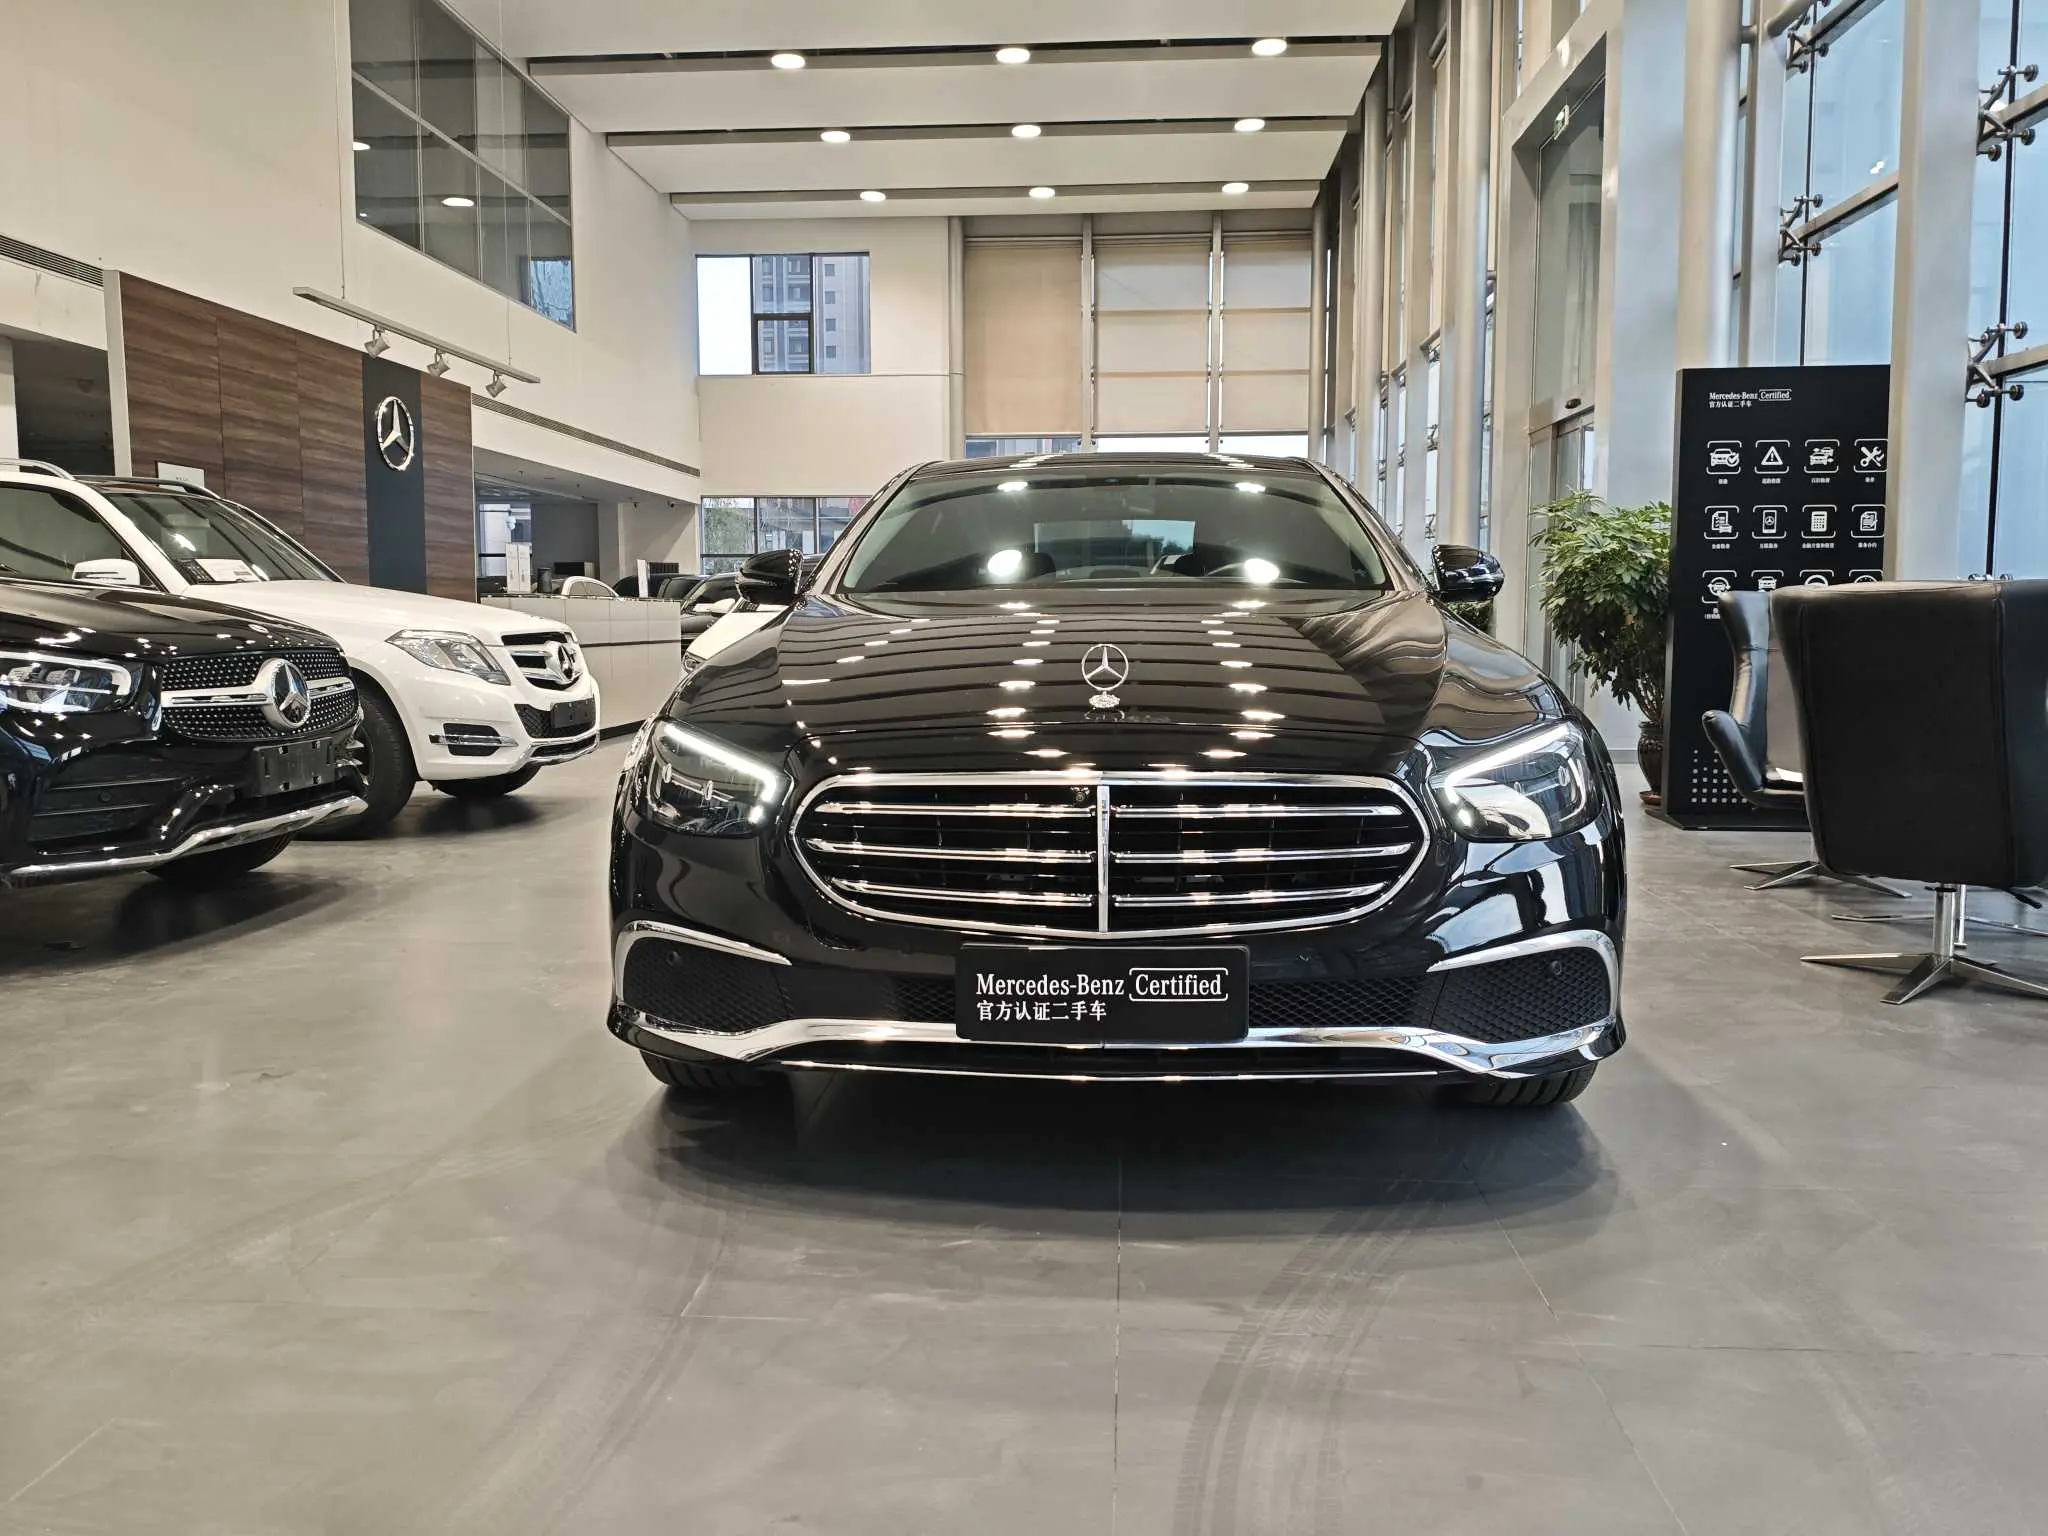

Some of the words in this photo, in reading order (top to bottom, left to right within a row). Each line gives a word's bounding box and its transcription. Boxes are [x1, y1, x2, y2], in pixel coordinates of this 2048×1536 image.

[1709, 391, 1758, 400] Mercedes-Benz
[1760, 391, 1790, 399] Certified
[976, 973, 1125, 996] Mercedes-Benz
[1135, 973, 1222, 996] Certified
[976, 1000, 1107, 1021] 官方认证二手车
